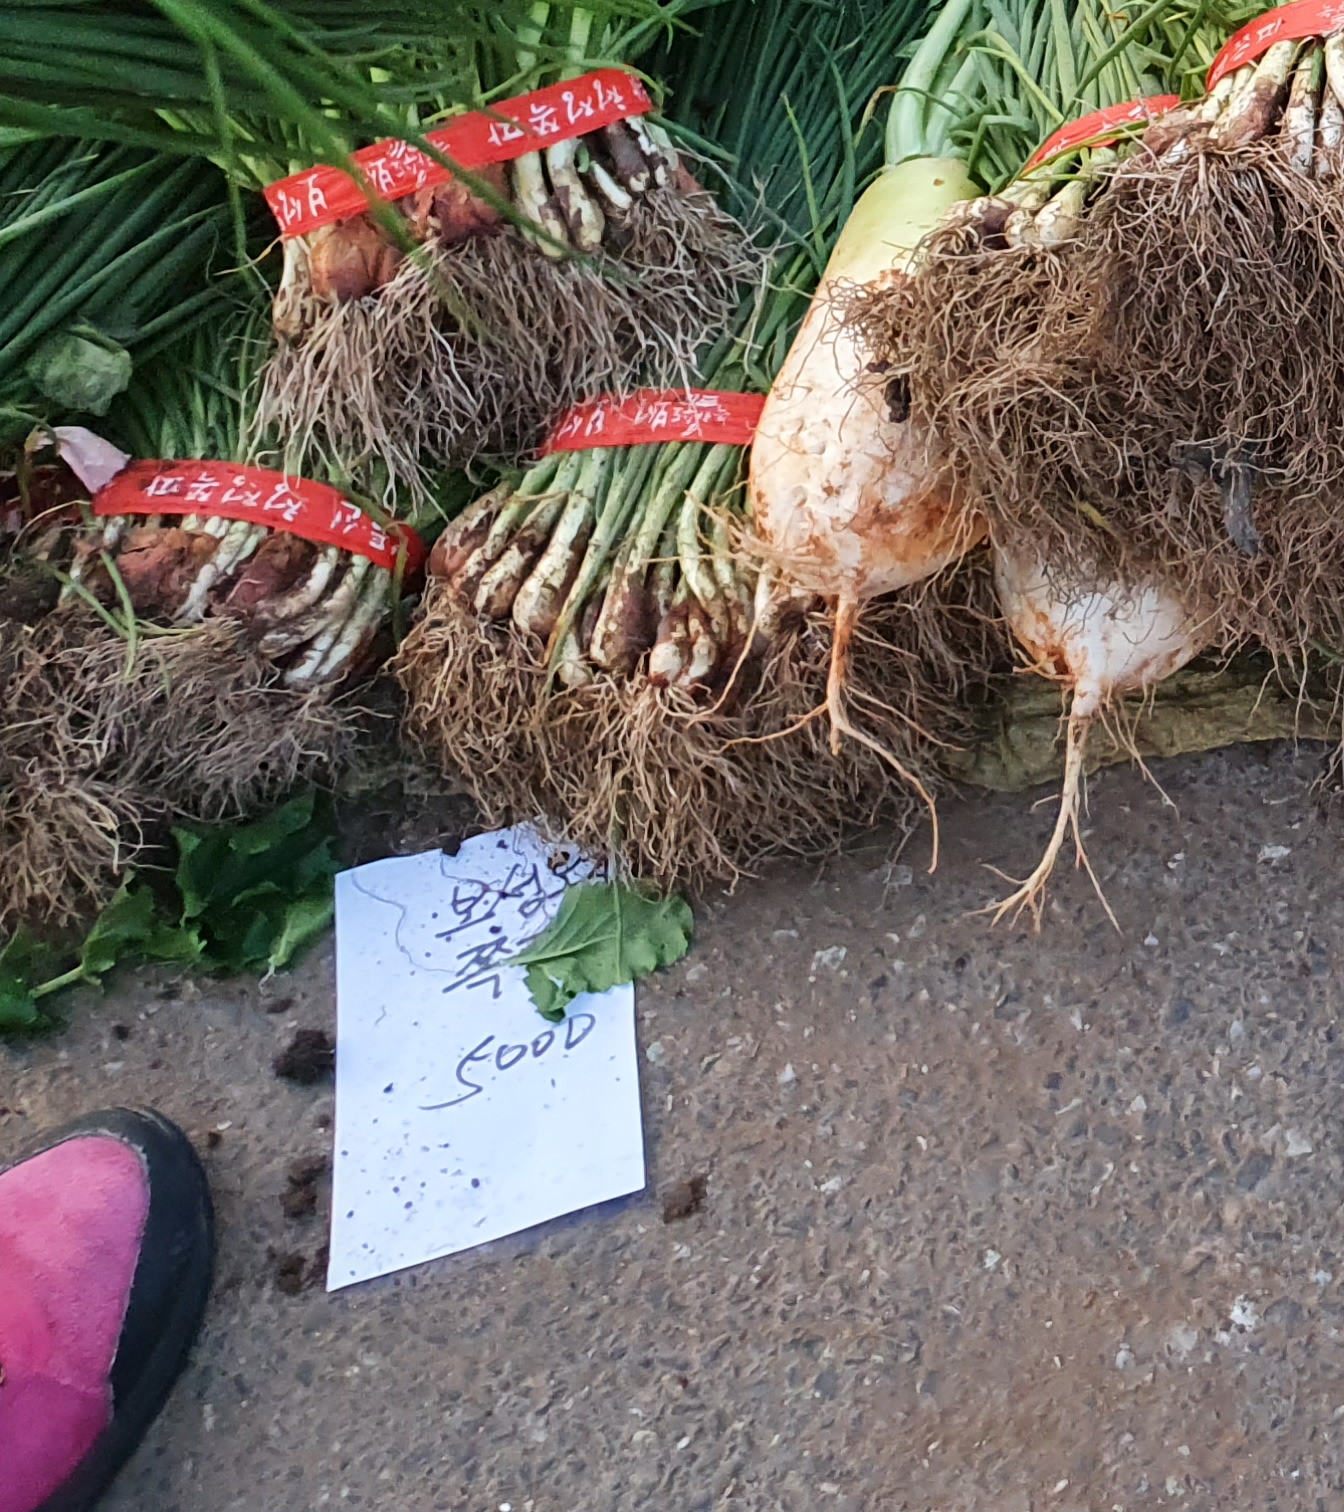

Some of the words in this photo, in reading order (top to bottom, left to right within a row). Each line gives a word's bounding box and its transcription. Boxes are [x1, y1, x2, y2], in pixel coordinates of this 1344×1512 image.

[486, 73, 627, 149] 청정쪽파
[143, 473, 308, 522] 청정쪽파
[417, 1013, 597, 1112] 5000
